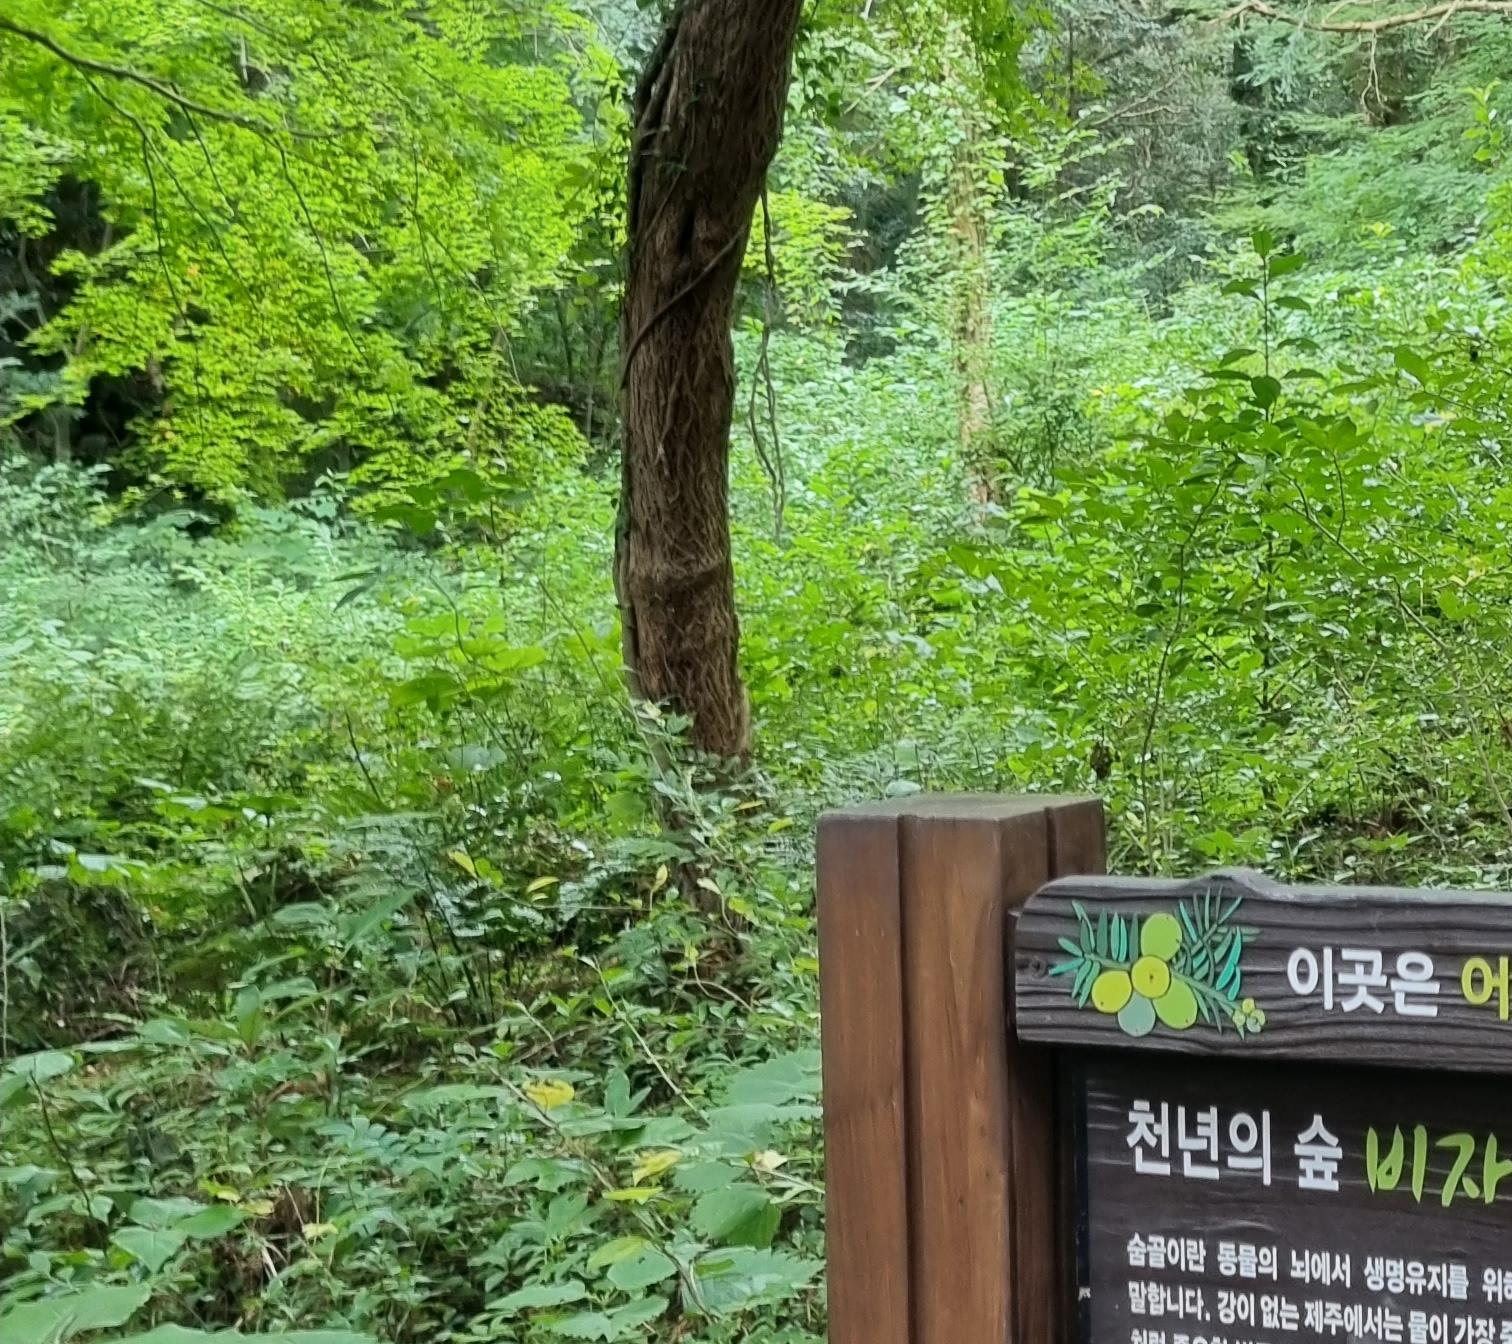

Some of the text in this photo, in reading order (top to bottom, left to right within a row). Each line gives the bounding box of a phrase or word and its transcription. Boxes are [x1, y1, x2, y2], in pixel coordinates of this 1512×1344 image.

[1286, 946, 1441, 1017] 이곳은
[1126, 1100, 1272, 1186] 천년의
[1294, 1115, 1343, 1192] 숲
[1126, 1232, 1207, 1273] 숨골이란
[1217, 1241, 1278, 1281] 동물의
[1290, 1249, 1351, 1289] 뇌에서
[1363, 1256, 1470, 1300] 생명유지를
[1128, 1281, 1211, 1322] 말합니다.
[1217, 1290, 1255, 1327] 강이
[1260, 1295, 1300, 1331] 없는
[1304, 1299, 1404, 1343] 제주에서는
